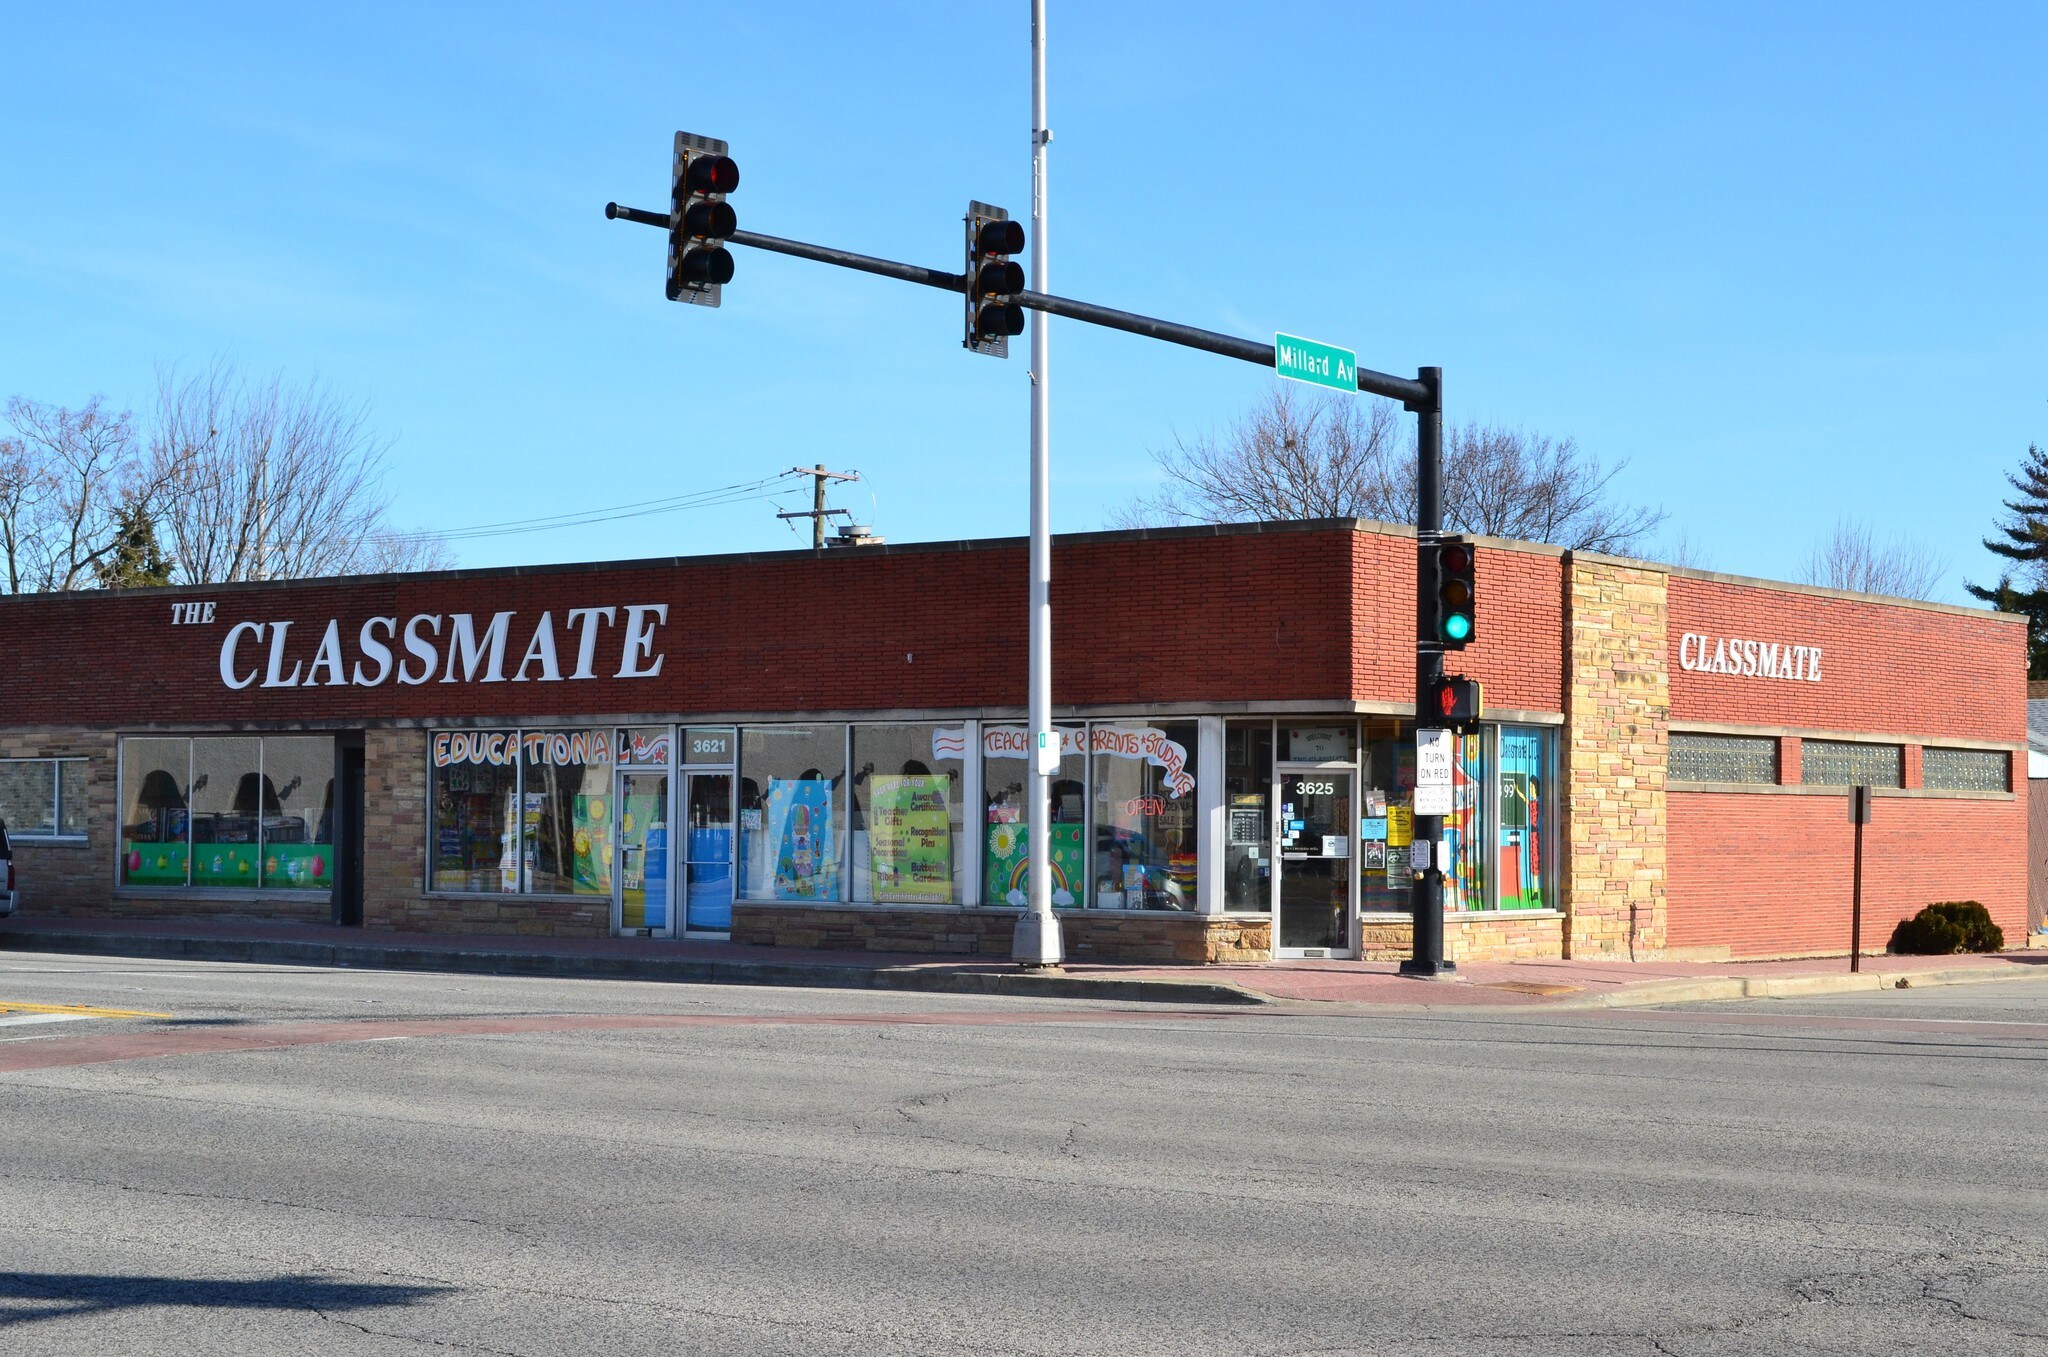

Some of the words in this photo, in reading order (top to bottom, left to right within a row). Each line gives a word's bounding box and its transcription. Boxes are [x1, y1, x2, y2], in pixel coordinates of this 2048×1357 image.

[1280, 344, 1329, 377] Millard
[1337, 359, 1353, 382] Av
[171, 602, 217, 625] THE
[219, 603, 669, 690] CLASSMATE
[1679, 632, 1822, 682] CLASSMATE
[693, 739, 727, 753] 3621
[1429, 736, 1440, 748] NO
[433, 731, 631, 767] EDUCATIONAL
[1074, 729, 1139, 754] PARENTS
[1146, 733, 1194, 798] STUDENTS
[1425, 753, 1445, 763] TURN
[1420, 768, 1431, 778] ON
[1434, 768, 1449, 778] RED
[1296, 782, 1334, 795] 3625
[879, 806, 908, 816] Teacher
[1125, 799, 1165, 816] OPEN
[885, 816, 903, 826] Gifts
[910, 826, 946, 838] Recognition
[876, 836, 905, 847] Seasonal
[921, 838, 936, 848] Pins
